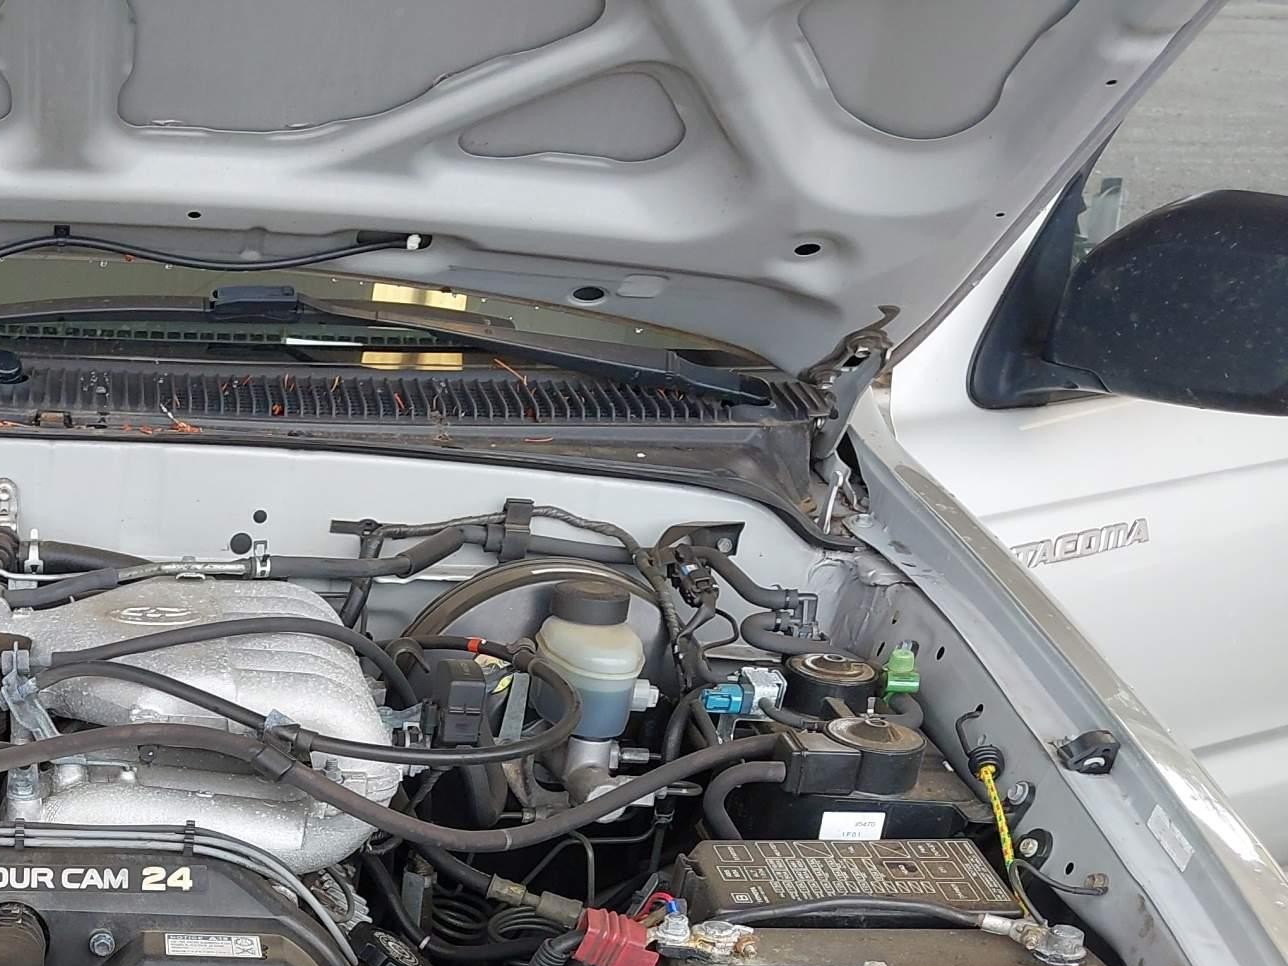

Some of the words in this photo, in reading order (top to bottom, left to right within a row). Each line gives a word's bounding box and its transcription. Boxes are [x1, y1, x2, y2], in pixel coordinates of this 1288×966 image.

[1010, 518, 1150, 568] TACOMA
[61, 868, 130, 890] CAM
[141, 866, 193, 891] 24
